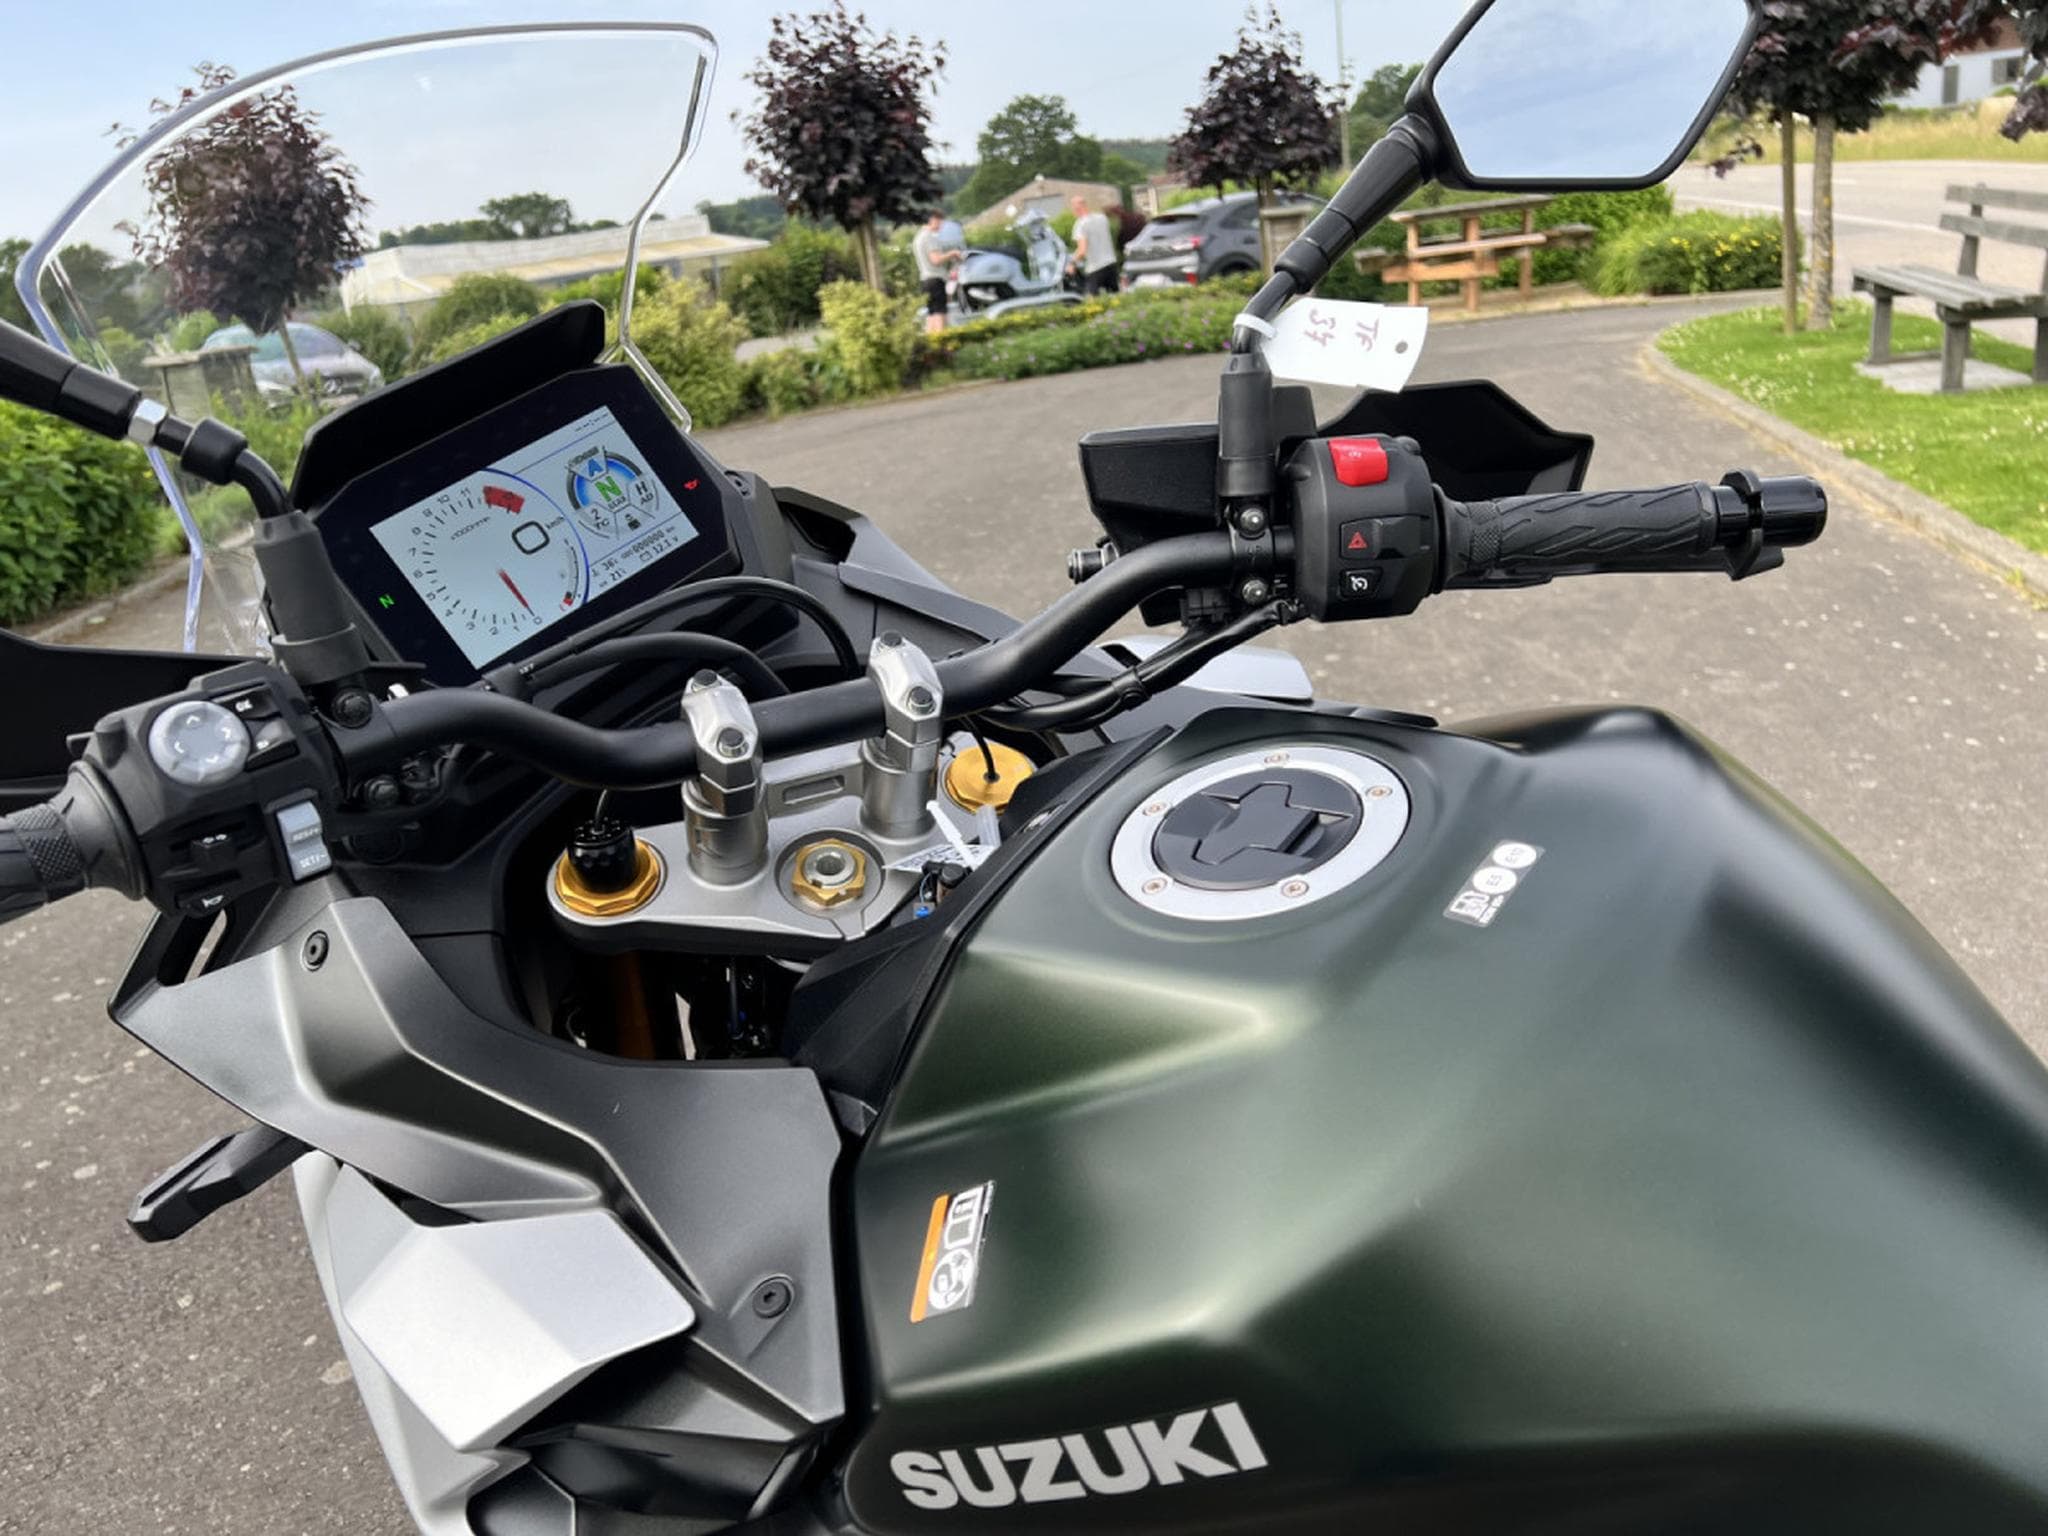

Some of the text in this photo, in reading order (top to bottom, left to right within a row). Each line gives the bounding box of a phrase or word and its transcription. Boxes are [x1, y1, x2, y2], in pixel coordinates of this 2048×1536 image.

[587, 458, 604, 477] A
[594, 475, 622, 502] N
[635, 481, 648, 495] H
[591, 508, 602, 520] 2
[511, 520, 550, 555] 0
[379, 593, 395, 609] N
[890, 1401, 1269, 1510] SUZUKI
